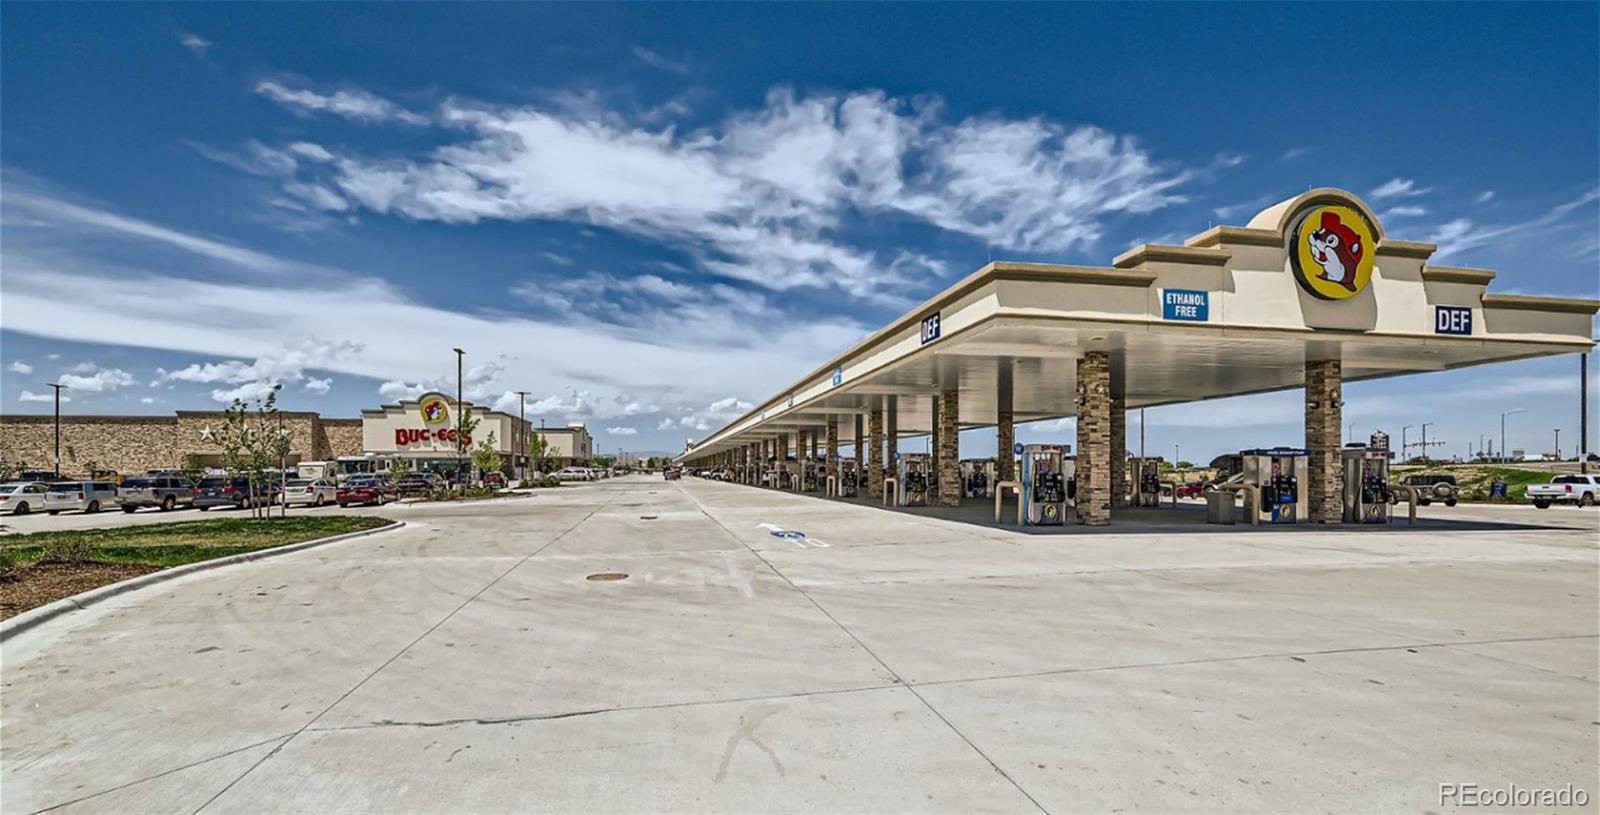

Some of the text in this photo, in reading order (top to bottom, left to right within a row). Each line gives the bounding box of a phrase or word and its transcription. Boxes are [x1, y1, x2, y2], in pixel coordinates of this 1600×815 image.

[1166, 292, 1205, 306] ETHANOL
[1175, 305, 1197, 317] FREE
[922, 315, 939, 342] DEF
[1438, 309, 1470, 332] DEF
